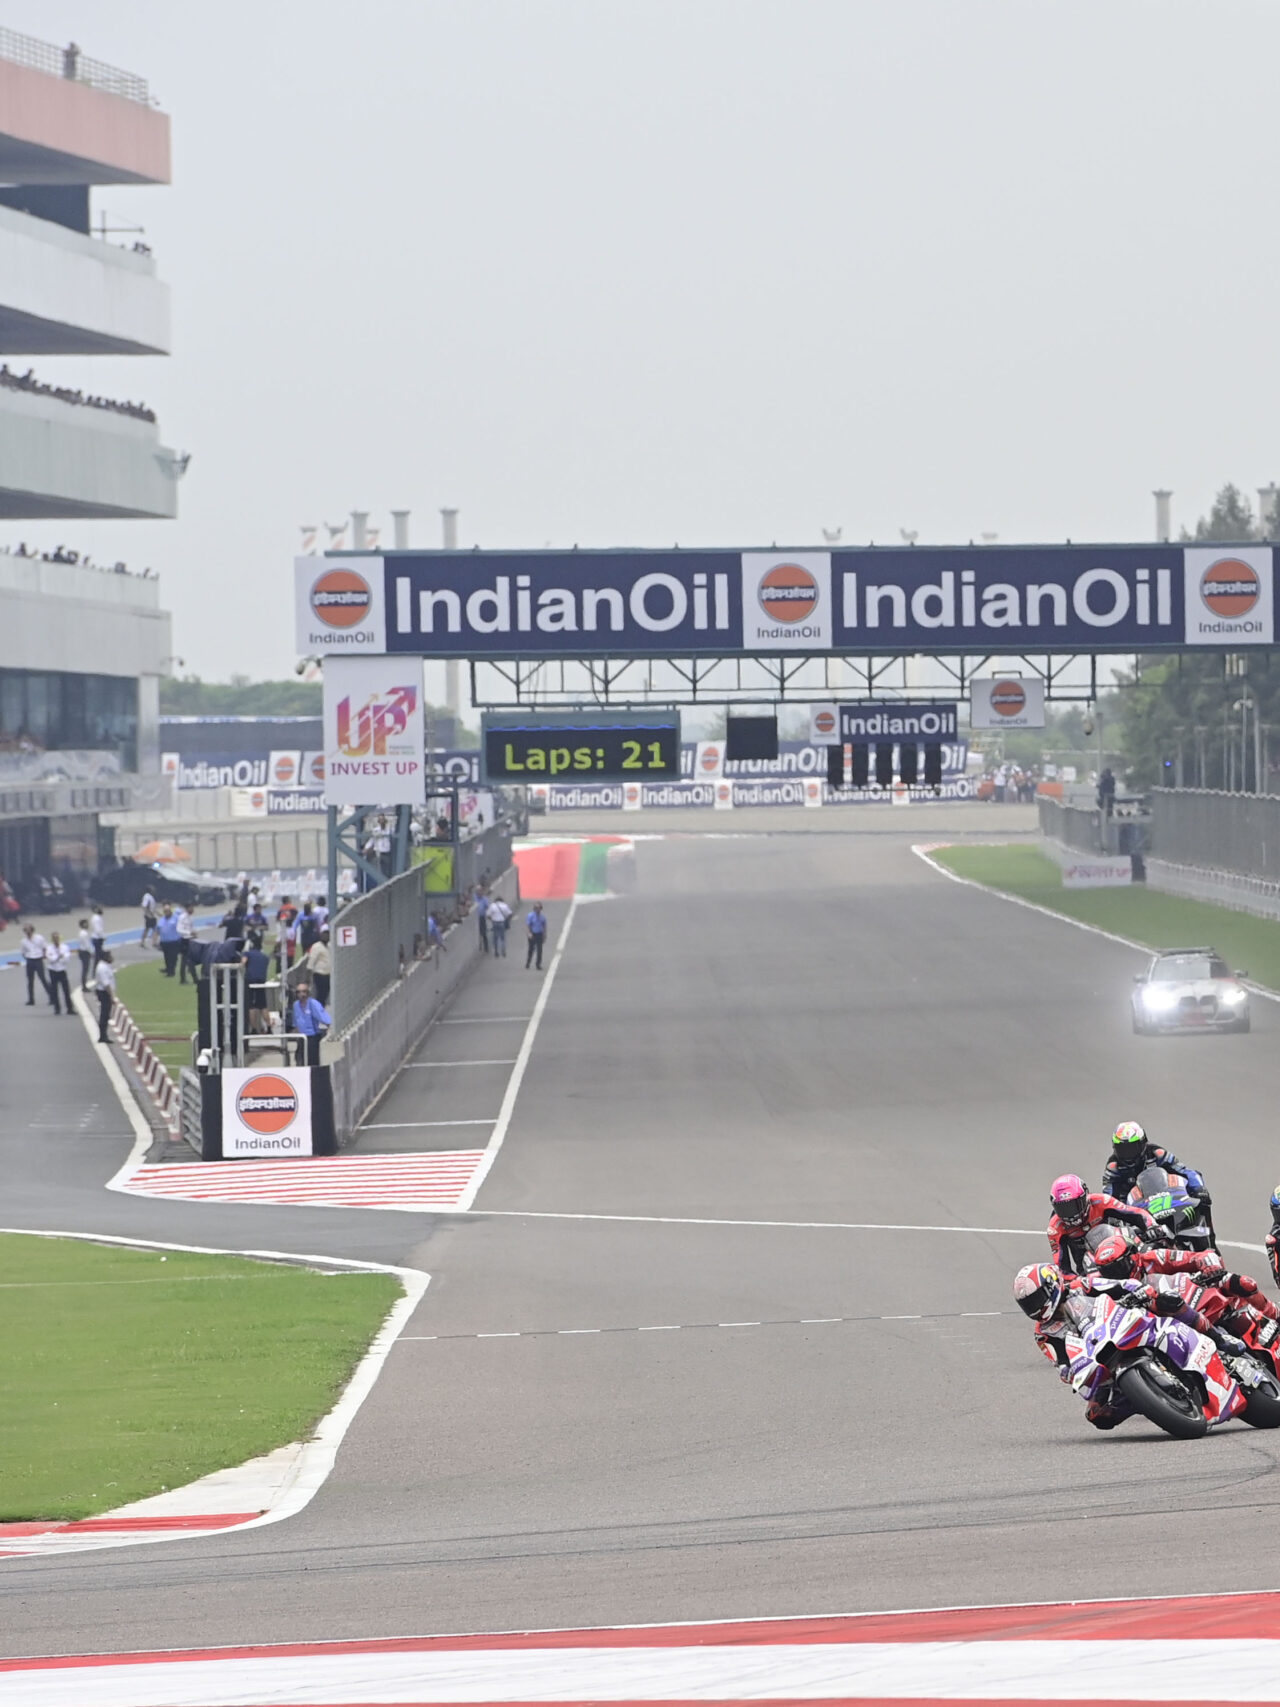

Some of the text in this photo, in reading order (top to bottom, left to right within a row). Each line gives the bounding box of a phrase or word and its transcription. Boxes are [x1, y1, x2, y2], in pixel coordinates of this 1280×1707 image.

[396, 573, 729, 634] IndianOil
[842, 568, 1172, 628] IndianOil
[757, 625, 821, 639] IndianOil
[1198, 621, 1263, 634] IndianOil
[309, 631, 375, 644] IndianOil
[842, 712, 954, 735] IndianOil
[505, 743, 605, 775] Laps:
[622, 740, 666, 769] 21
[178, 759, 267, 788] IndianOil
[330, 762, 391, 776] INVEST
[396, 761, 418, 775] UP
[551, 787, 622, 807] IndianOil
[643, 786, 713, 805] IndianOil
[342, 928, 353, 944] F
[235, 1136, 301, 1150] IndianOil
[1147, 1195, 1173, 1214] 21
